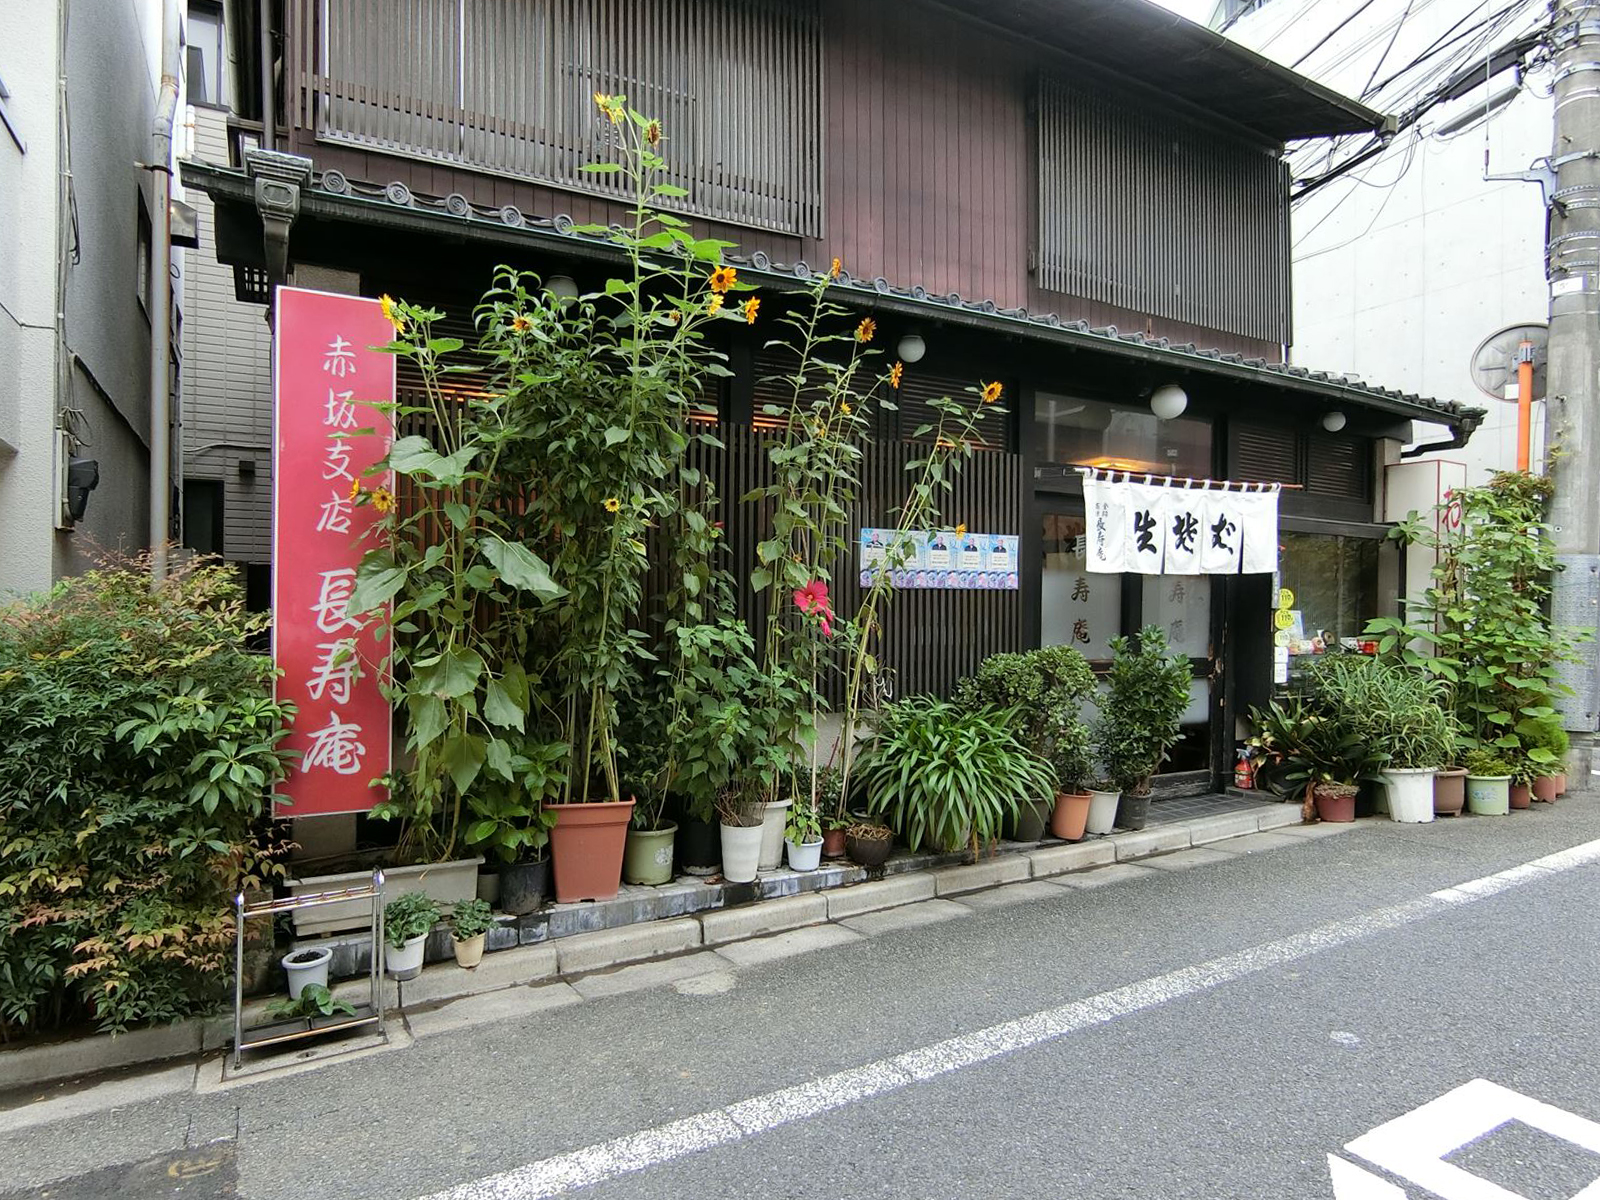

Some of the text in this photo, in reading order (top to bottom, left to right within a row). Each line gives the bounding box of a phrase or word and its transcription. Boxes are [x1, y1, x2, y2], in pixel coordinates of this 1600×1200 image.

[301, 334, 366, 774] 赤坂支店 長寿庵
